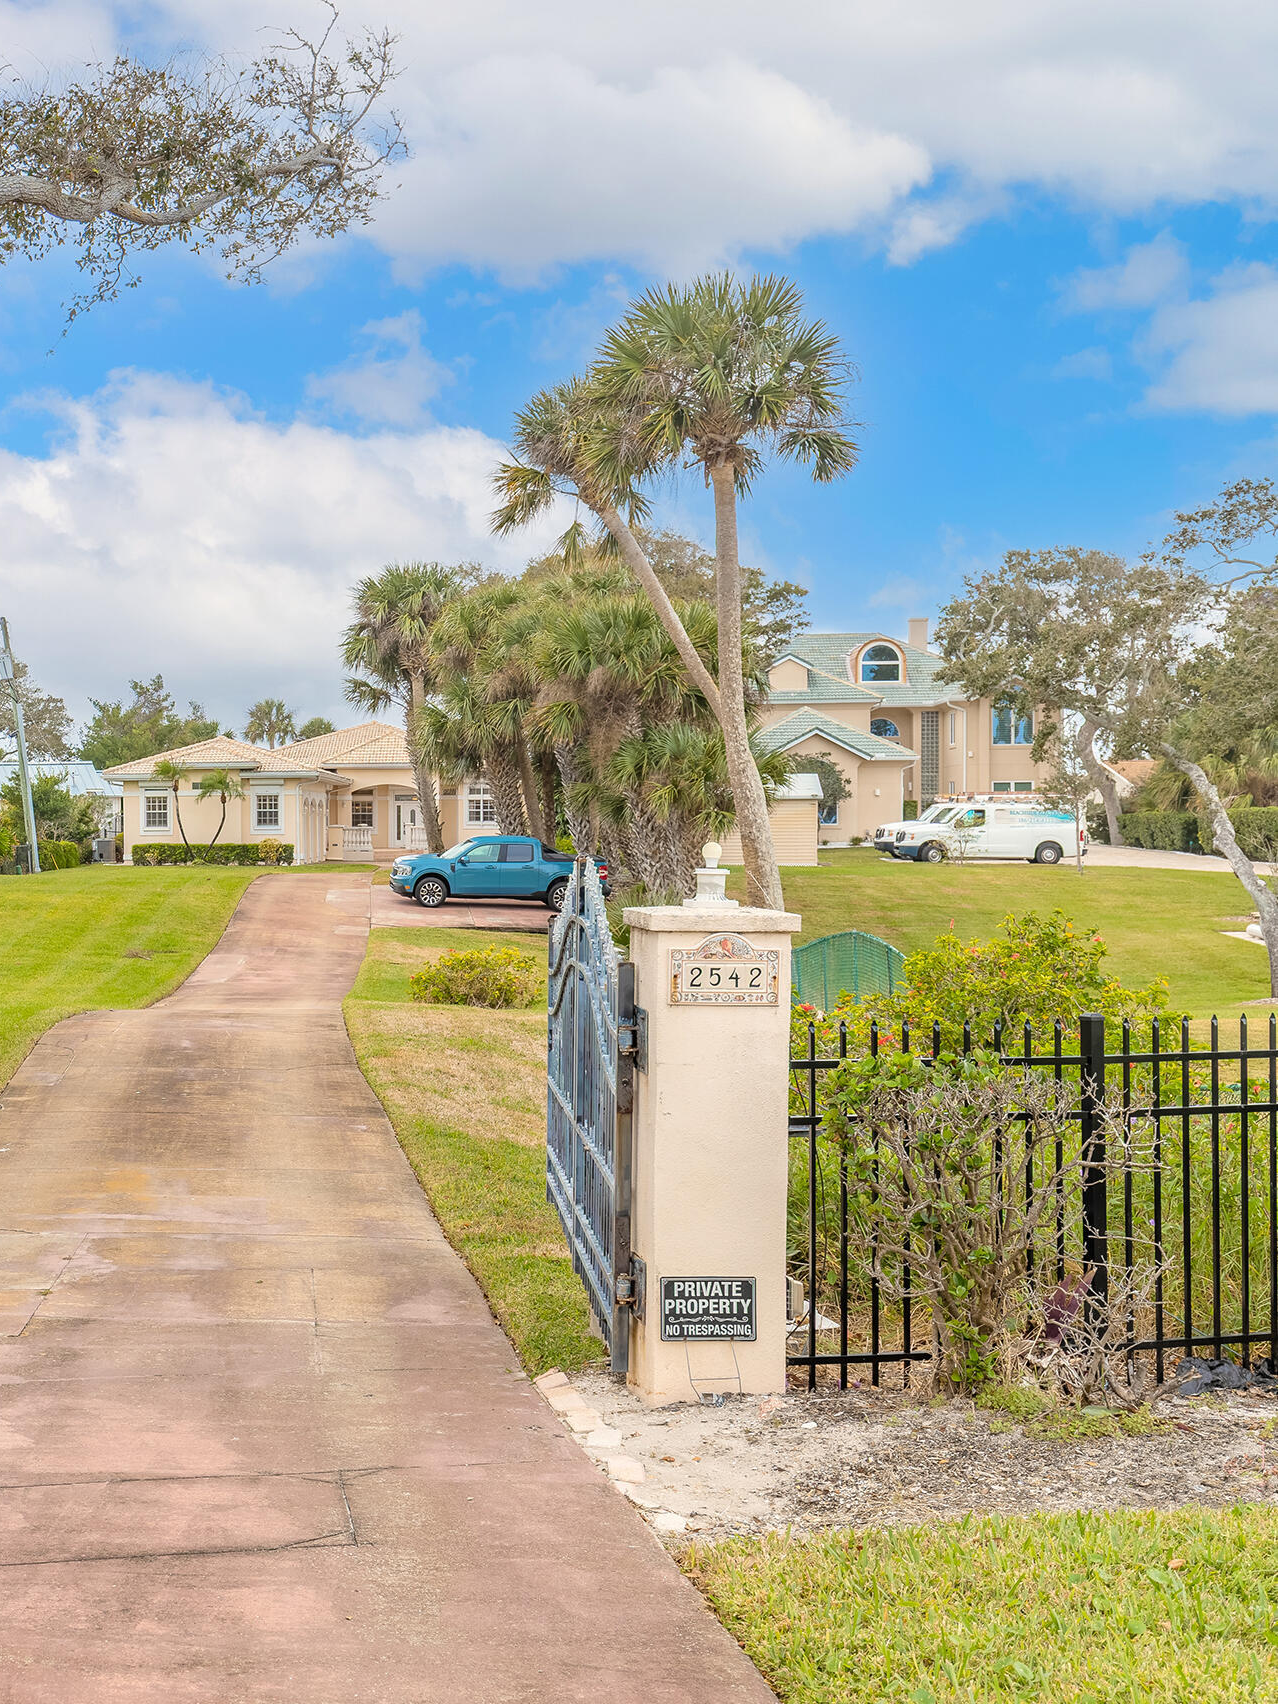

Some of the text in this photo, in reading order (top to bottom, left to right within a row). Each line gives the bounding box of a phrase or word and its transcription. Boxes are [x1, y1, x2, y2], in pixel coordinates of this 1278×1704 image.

[690, 967, 762, 988] 2542
[673, 1281, 742, 1297] PRIVATE
[665, 1299, 752, 1314] PROPERTY
[665, 1324, 752, 1336] NO TRESPASSING
